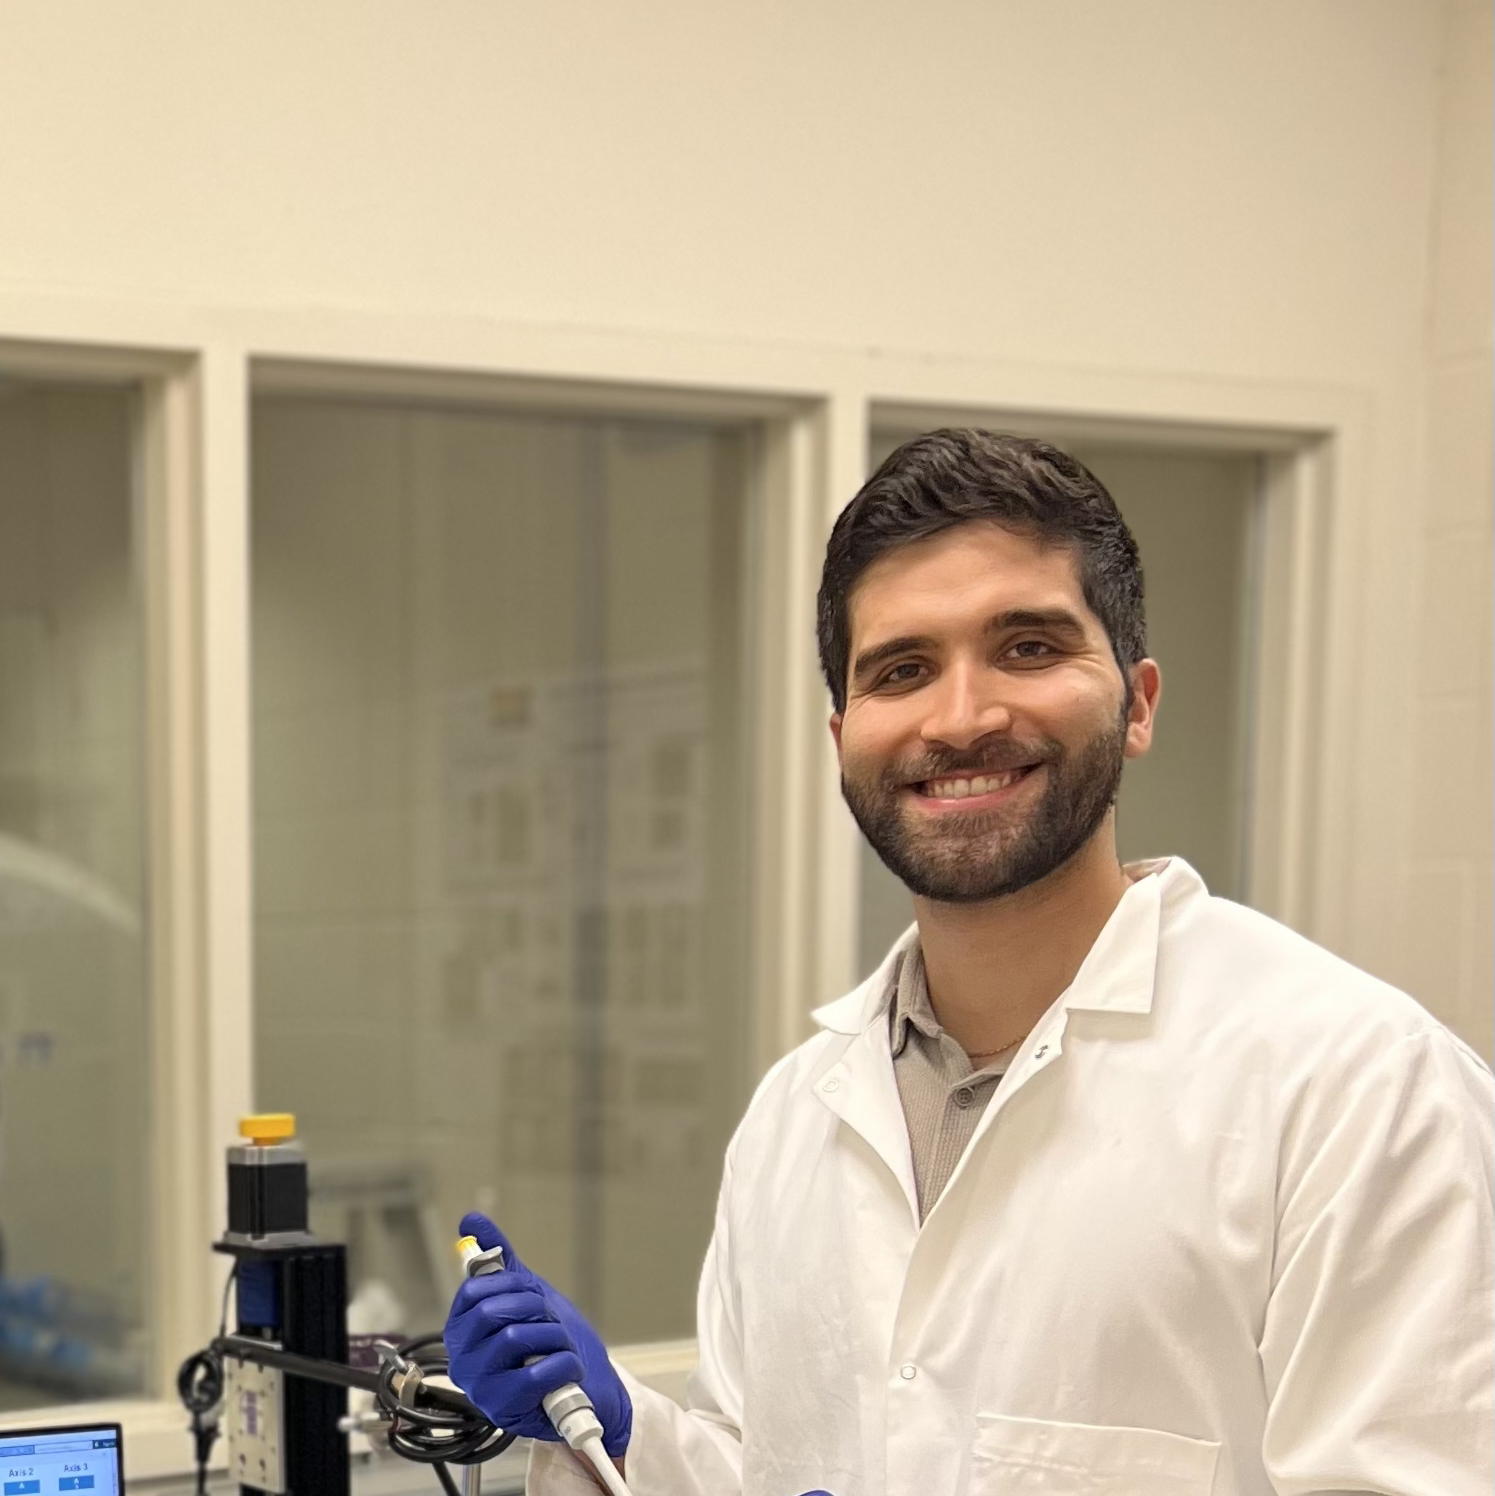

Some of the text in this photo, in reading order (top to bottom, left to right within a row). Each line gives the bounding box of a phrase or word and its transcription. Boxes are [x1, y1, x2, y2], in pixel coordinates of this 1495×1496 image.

[64, 1463, 88, 1472] Axis 3
[9, 1468, 34, 1477] Axis 2
